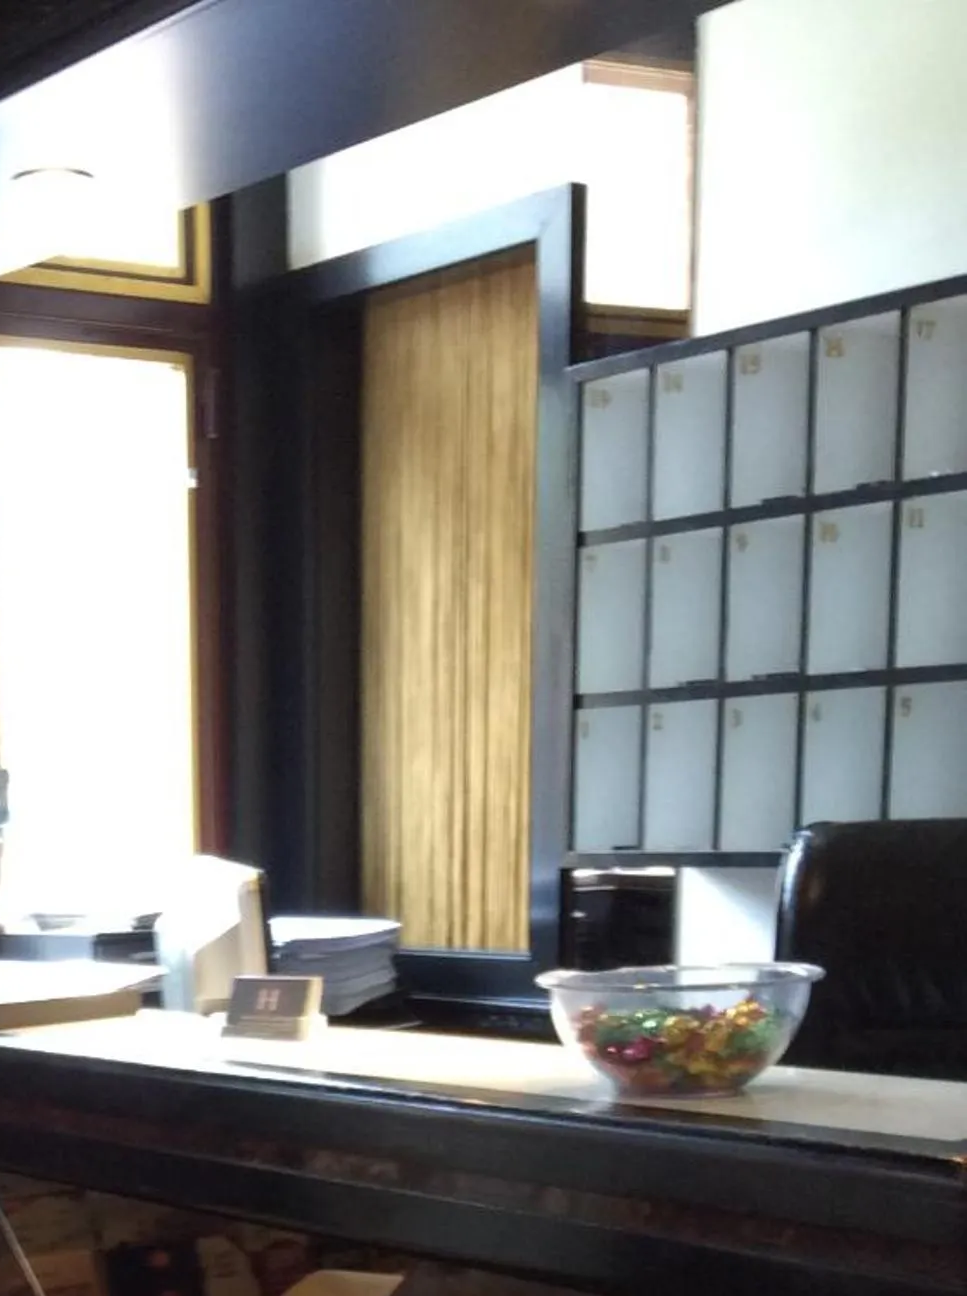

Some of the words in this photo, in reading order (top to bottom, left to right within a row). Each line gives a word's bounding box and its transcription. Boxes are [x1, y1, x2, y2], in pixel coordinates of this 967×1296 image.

[915, 319, 937, 340] 17
[908, 508, 925, 529] 11
[900, 695, 913, 718] 5
